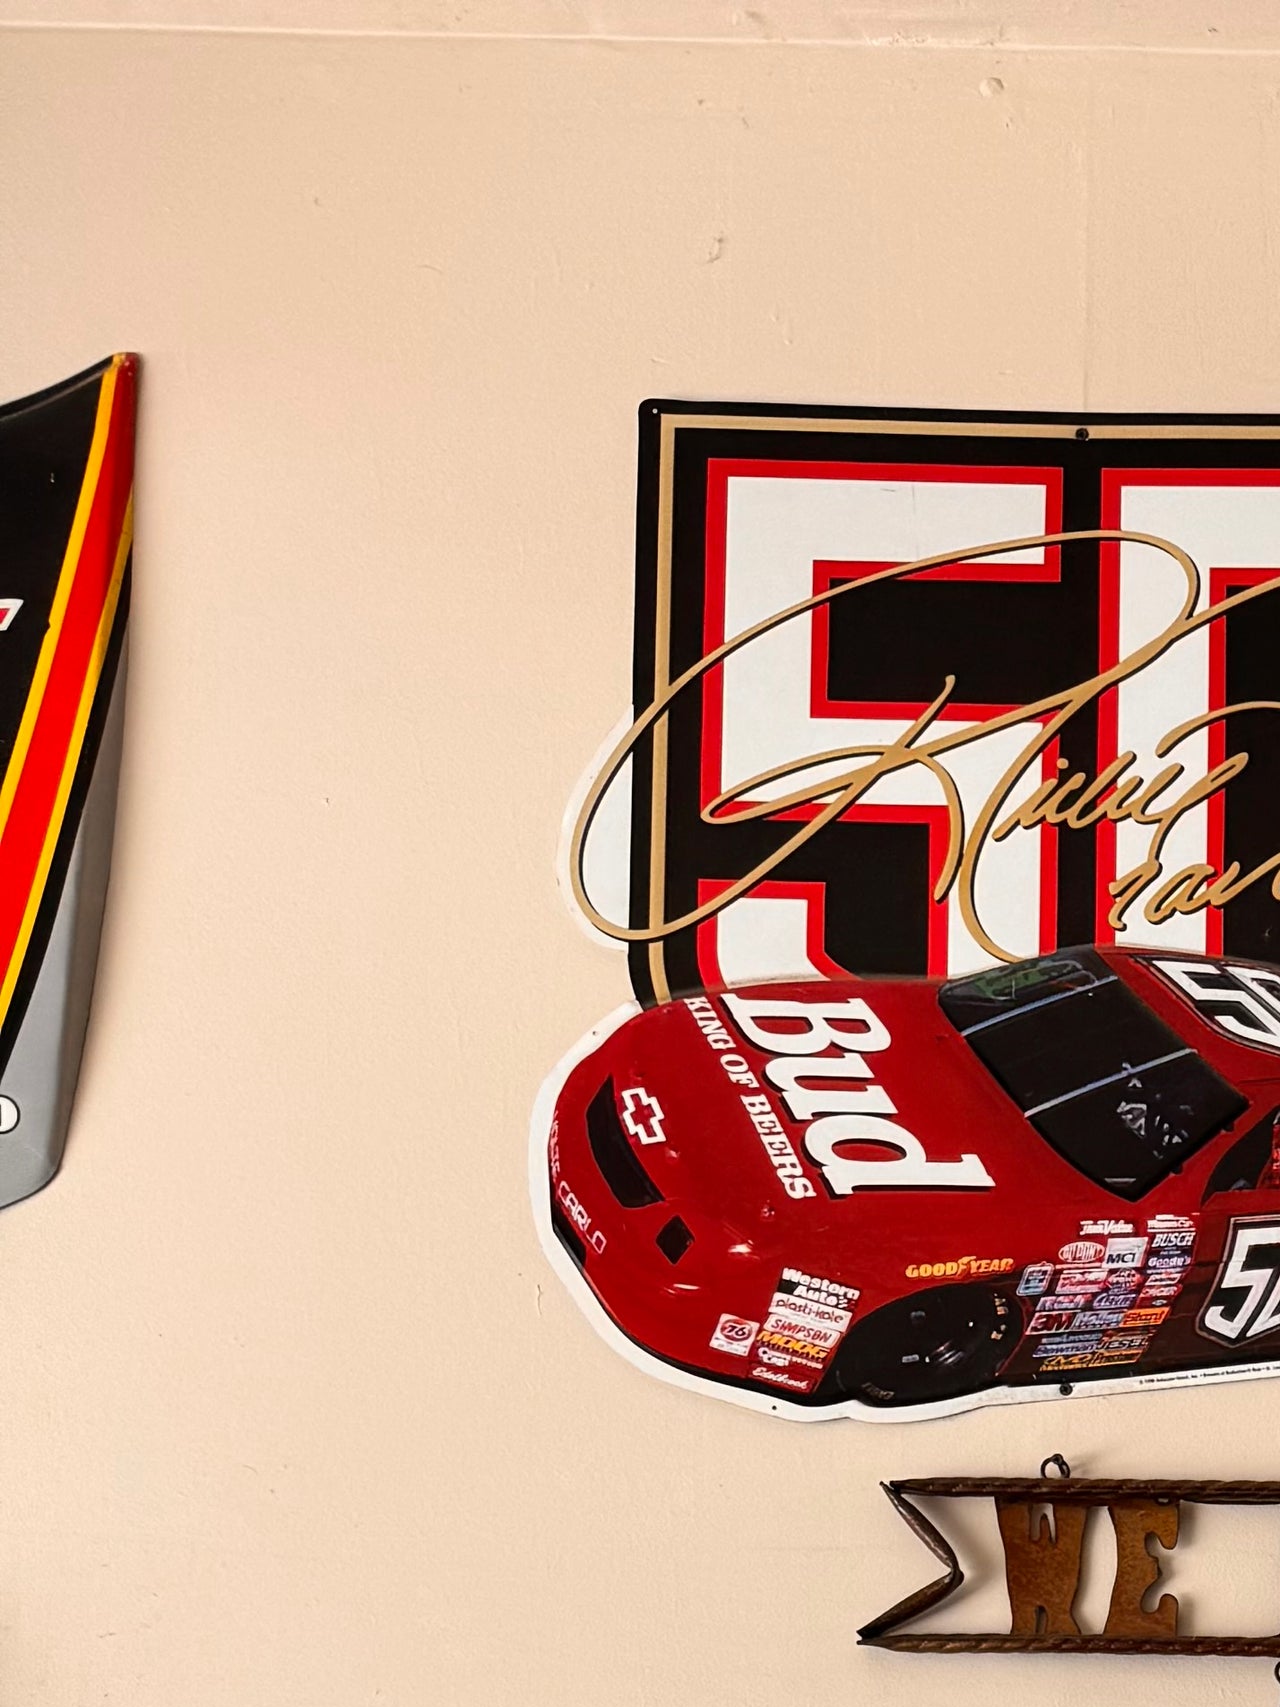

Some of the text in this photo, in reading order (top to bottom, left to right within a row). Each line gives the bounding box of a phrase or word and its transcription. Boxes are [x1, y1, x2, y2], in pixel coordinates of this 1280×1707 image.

[688, 996, 818, 1200] KING OF BEERS
[720, 993, 996, 1196] Bud
[558, 1180, 608, 1255] CARLO
[1152, 1232, 1197, 1248] BUSCH
[904, 1256, 1014, 1278] GOODYEAR
[1106, 1252, 1136, 1265] MCI
[781, 1267, 861, 1300] Western
[792, 1285, 838, 1307] Auto
[726, 1323, 748, 1337] 76
[771, 1318, 833, 1344] SIMPSON
[995, 1497, 1181, 1637] WE
